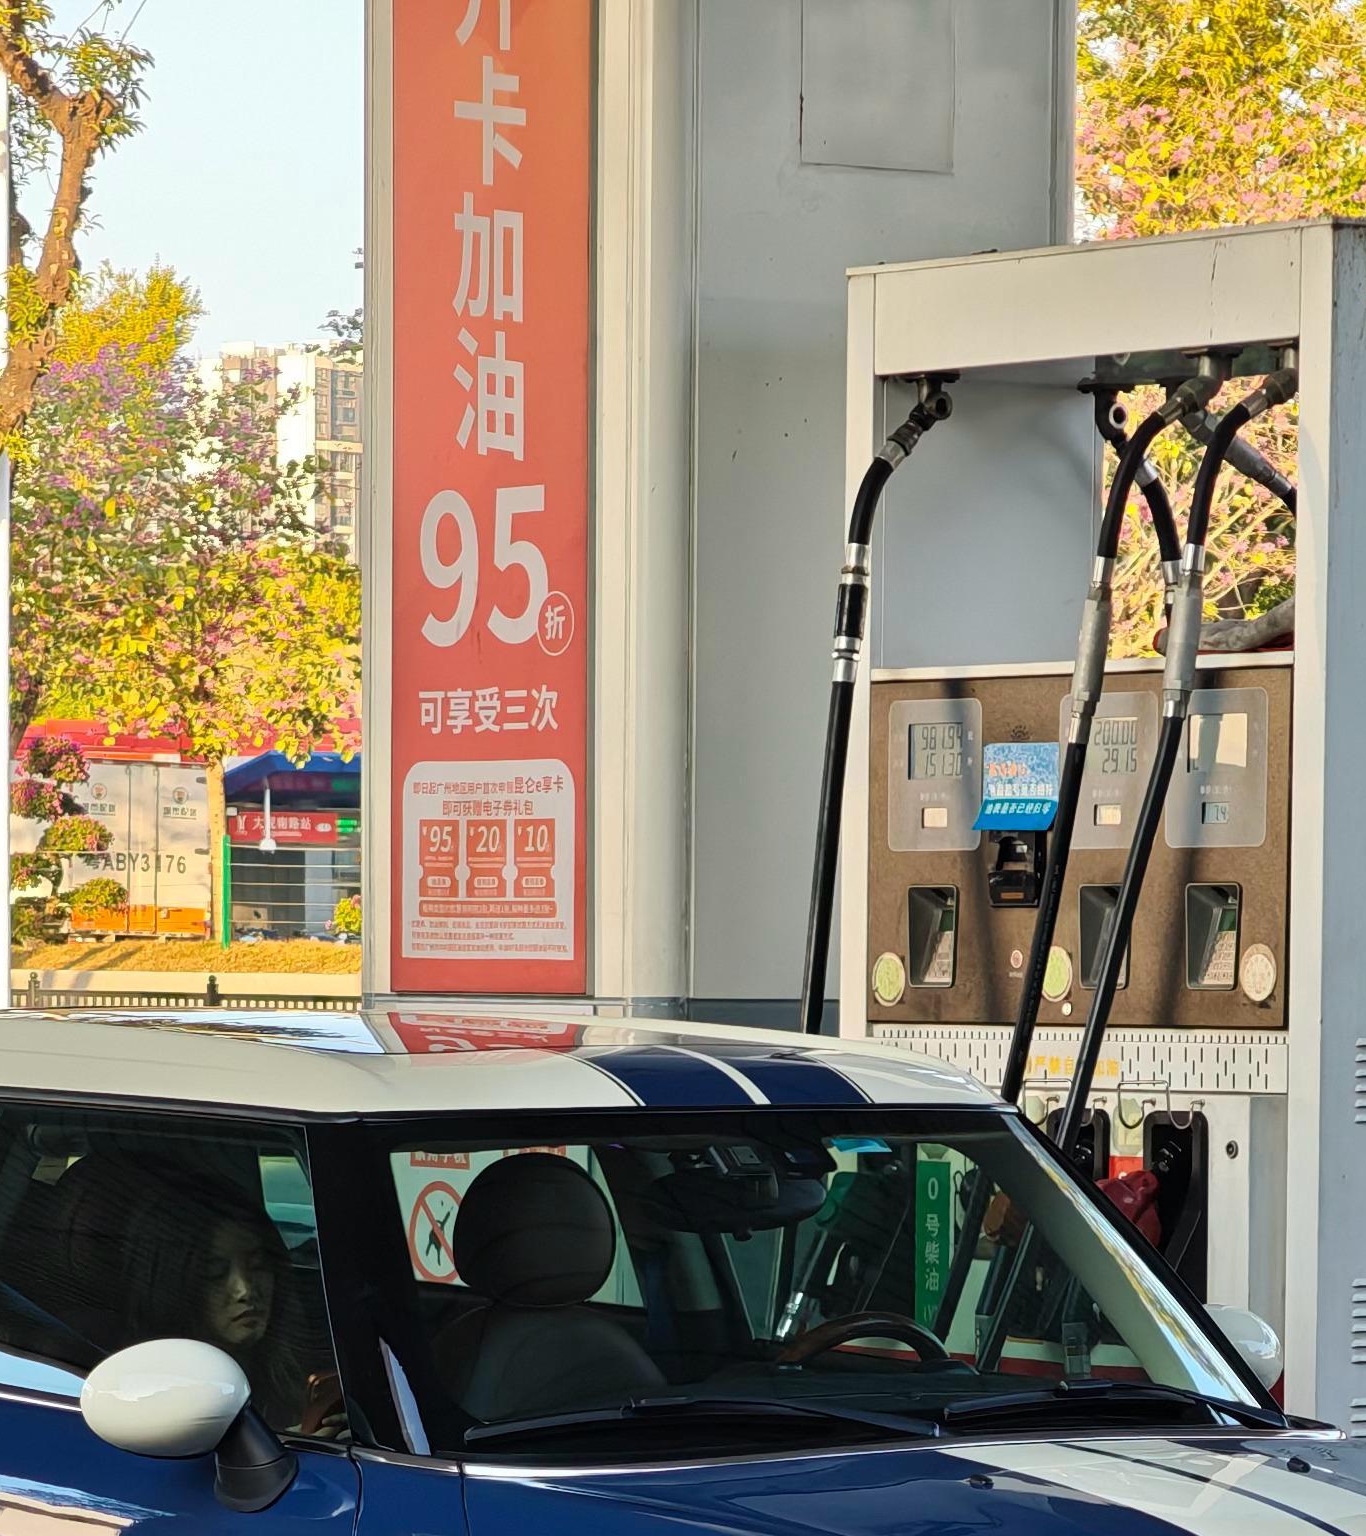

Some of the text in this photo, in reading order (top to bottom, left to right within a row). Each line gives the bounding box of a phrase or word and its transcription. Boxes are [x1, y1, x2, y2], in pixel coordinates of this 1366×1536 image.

[420, 484, 567, 648] 95 折
[418, 684, 559, 735] 可享受三次
